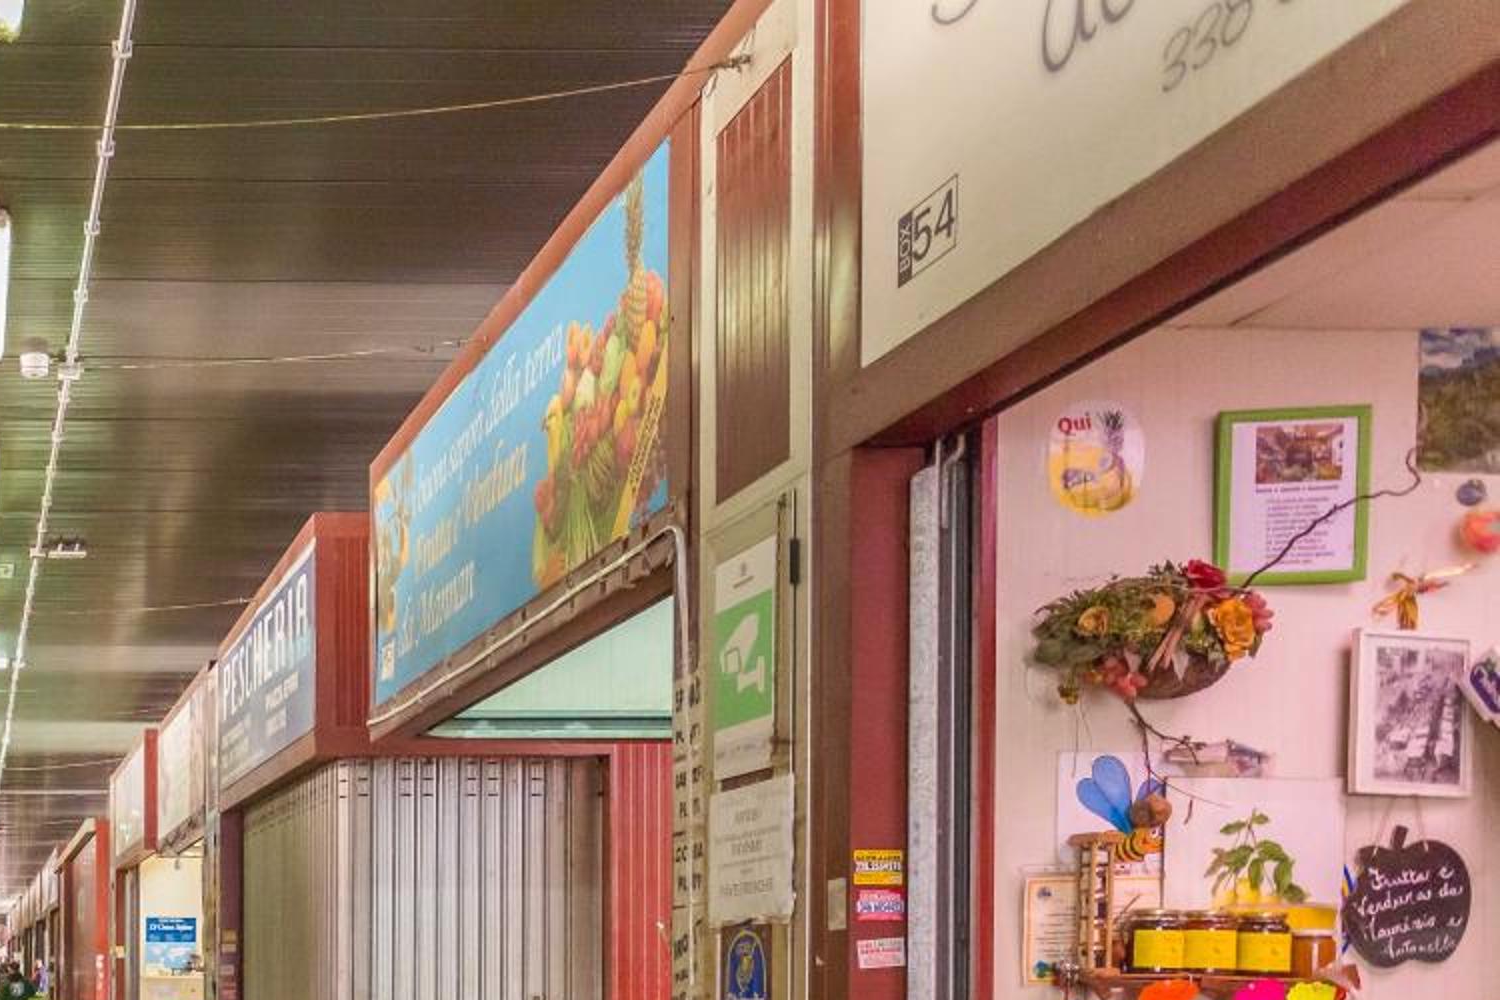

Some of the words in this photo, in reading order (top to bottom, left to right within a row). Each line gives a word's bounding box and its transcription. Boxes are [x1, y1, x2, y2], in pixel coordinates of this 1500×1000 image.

[900, 222, 911, 272] BOX
[913, 188, 954, 261] 54
[1058, 411, 1092, 436] Qui
[222, 573, 309, 722] PESCHERIA
[1368, 867, 1430, 890] Frutta
